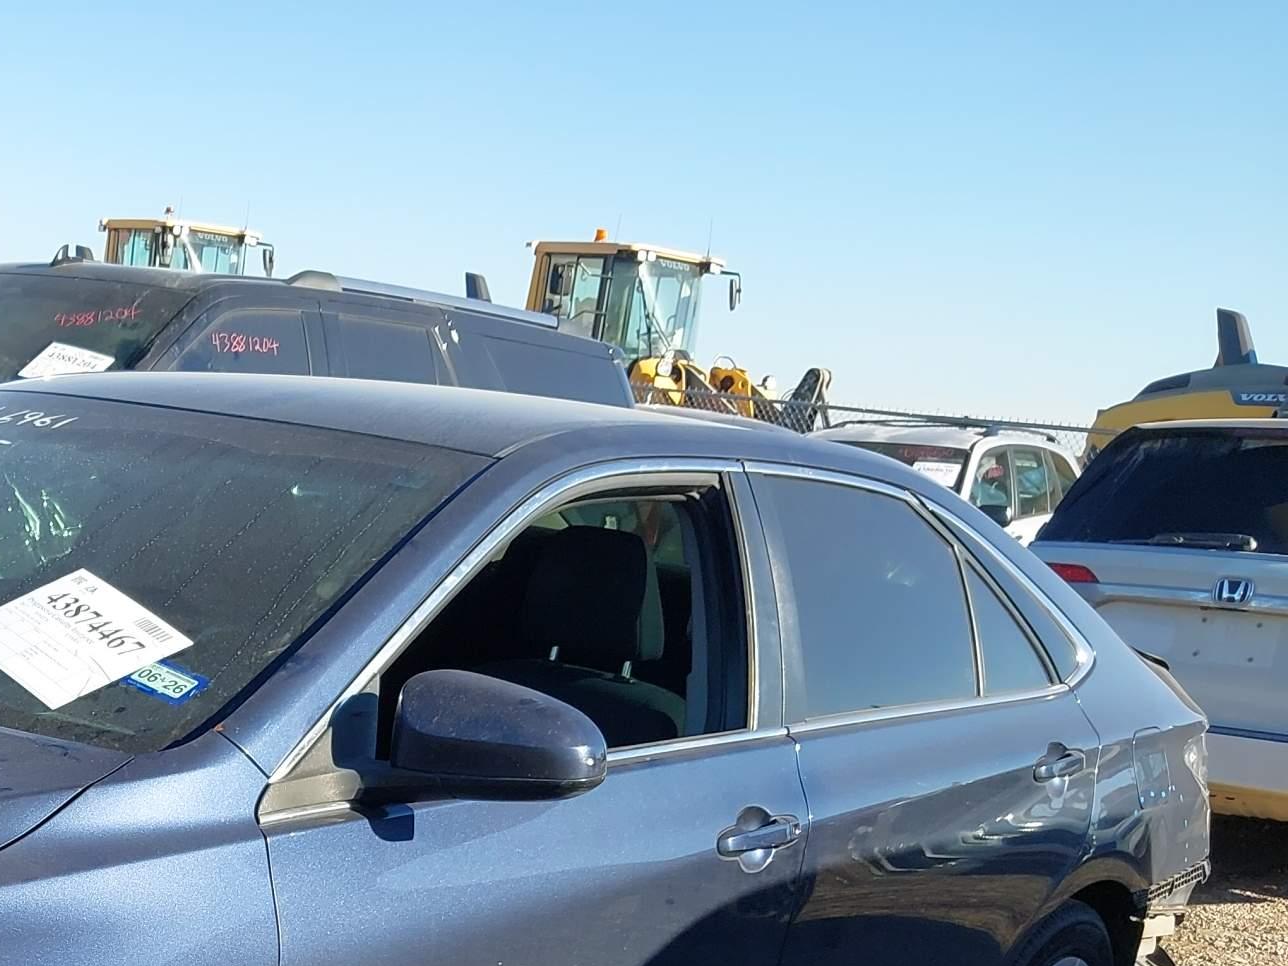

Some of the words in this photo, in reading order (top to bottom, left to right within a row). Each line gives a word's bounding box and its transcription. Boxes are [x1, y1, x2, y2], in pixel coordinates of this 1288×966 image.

[211, 332, 280, 355] 43881204
[47, 592, 146, 656] 43874467
[137, 668, 162, 683] 06
[162, 680, 188, 694] 26
